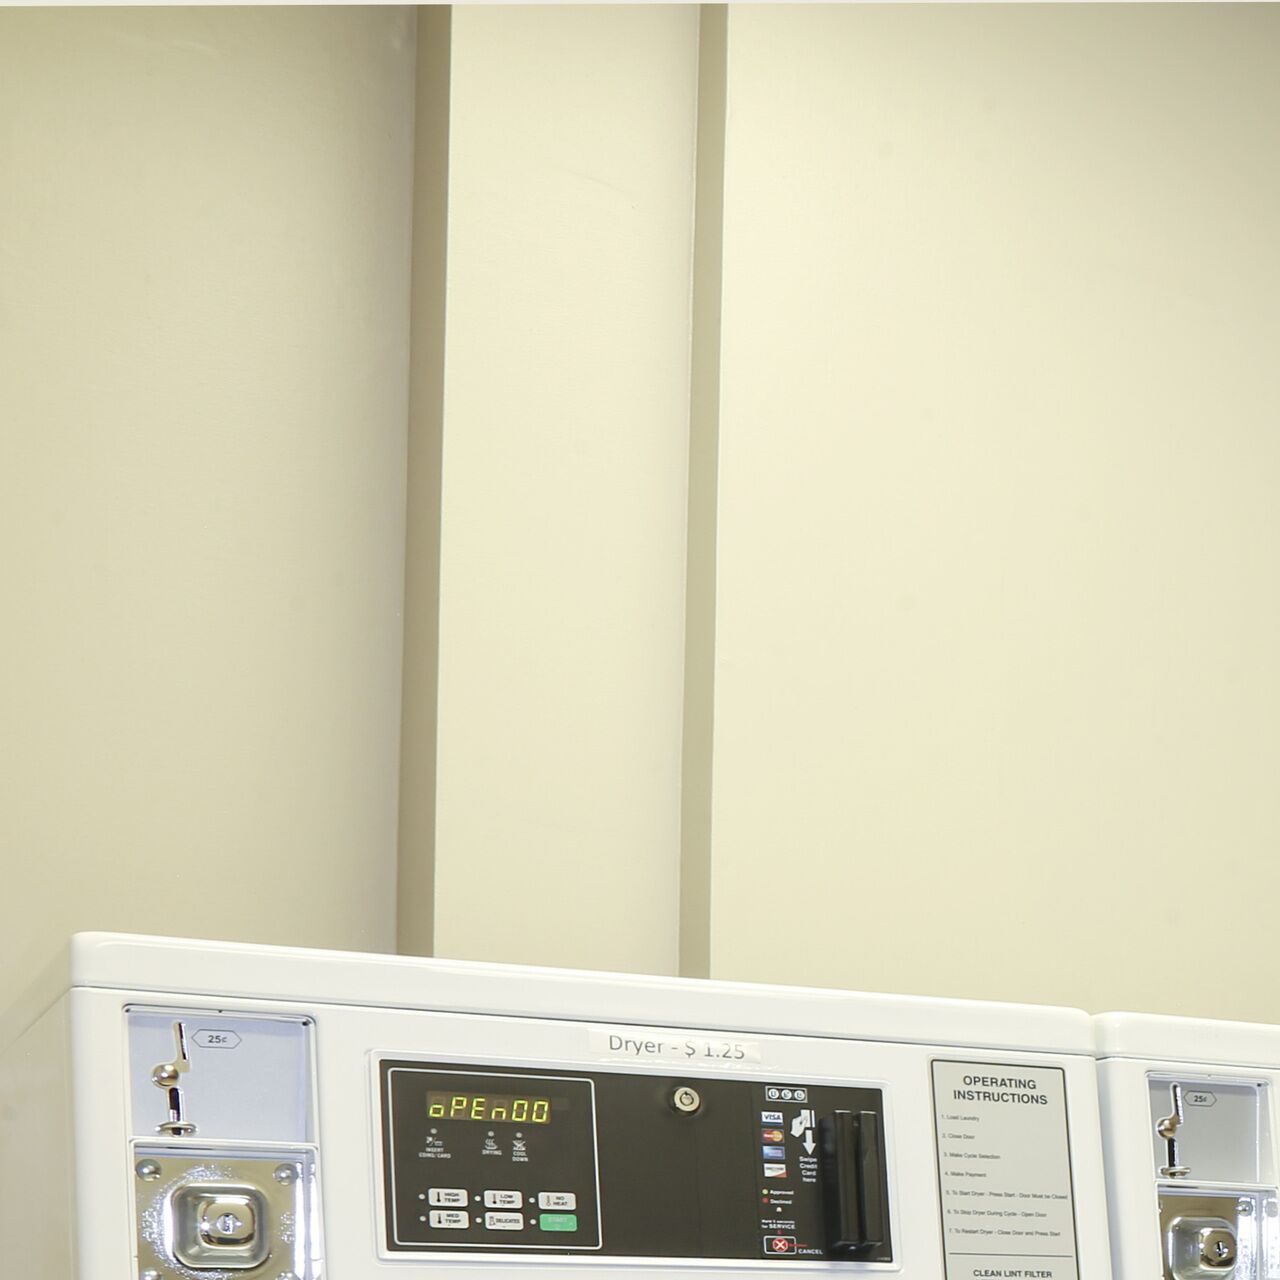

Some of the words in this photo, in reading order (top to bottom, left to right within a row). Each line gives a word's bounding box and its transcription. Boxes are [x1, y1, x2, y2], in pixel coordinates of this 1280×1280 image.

[609, 1035, 664, 1055] Dryer
[685, 1040, 696, 1058] $
[704, 1042, 745, 1060] 1.25
[963, 1075, 1037, 1090] OPERATING
[953, 1090, 1048, 1105] INSTRUCTIONS
[973, 1269, 1002, 1277] CLEAN
[1004, 1270, 1022, 1278] LINT
